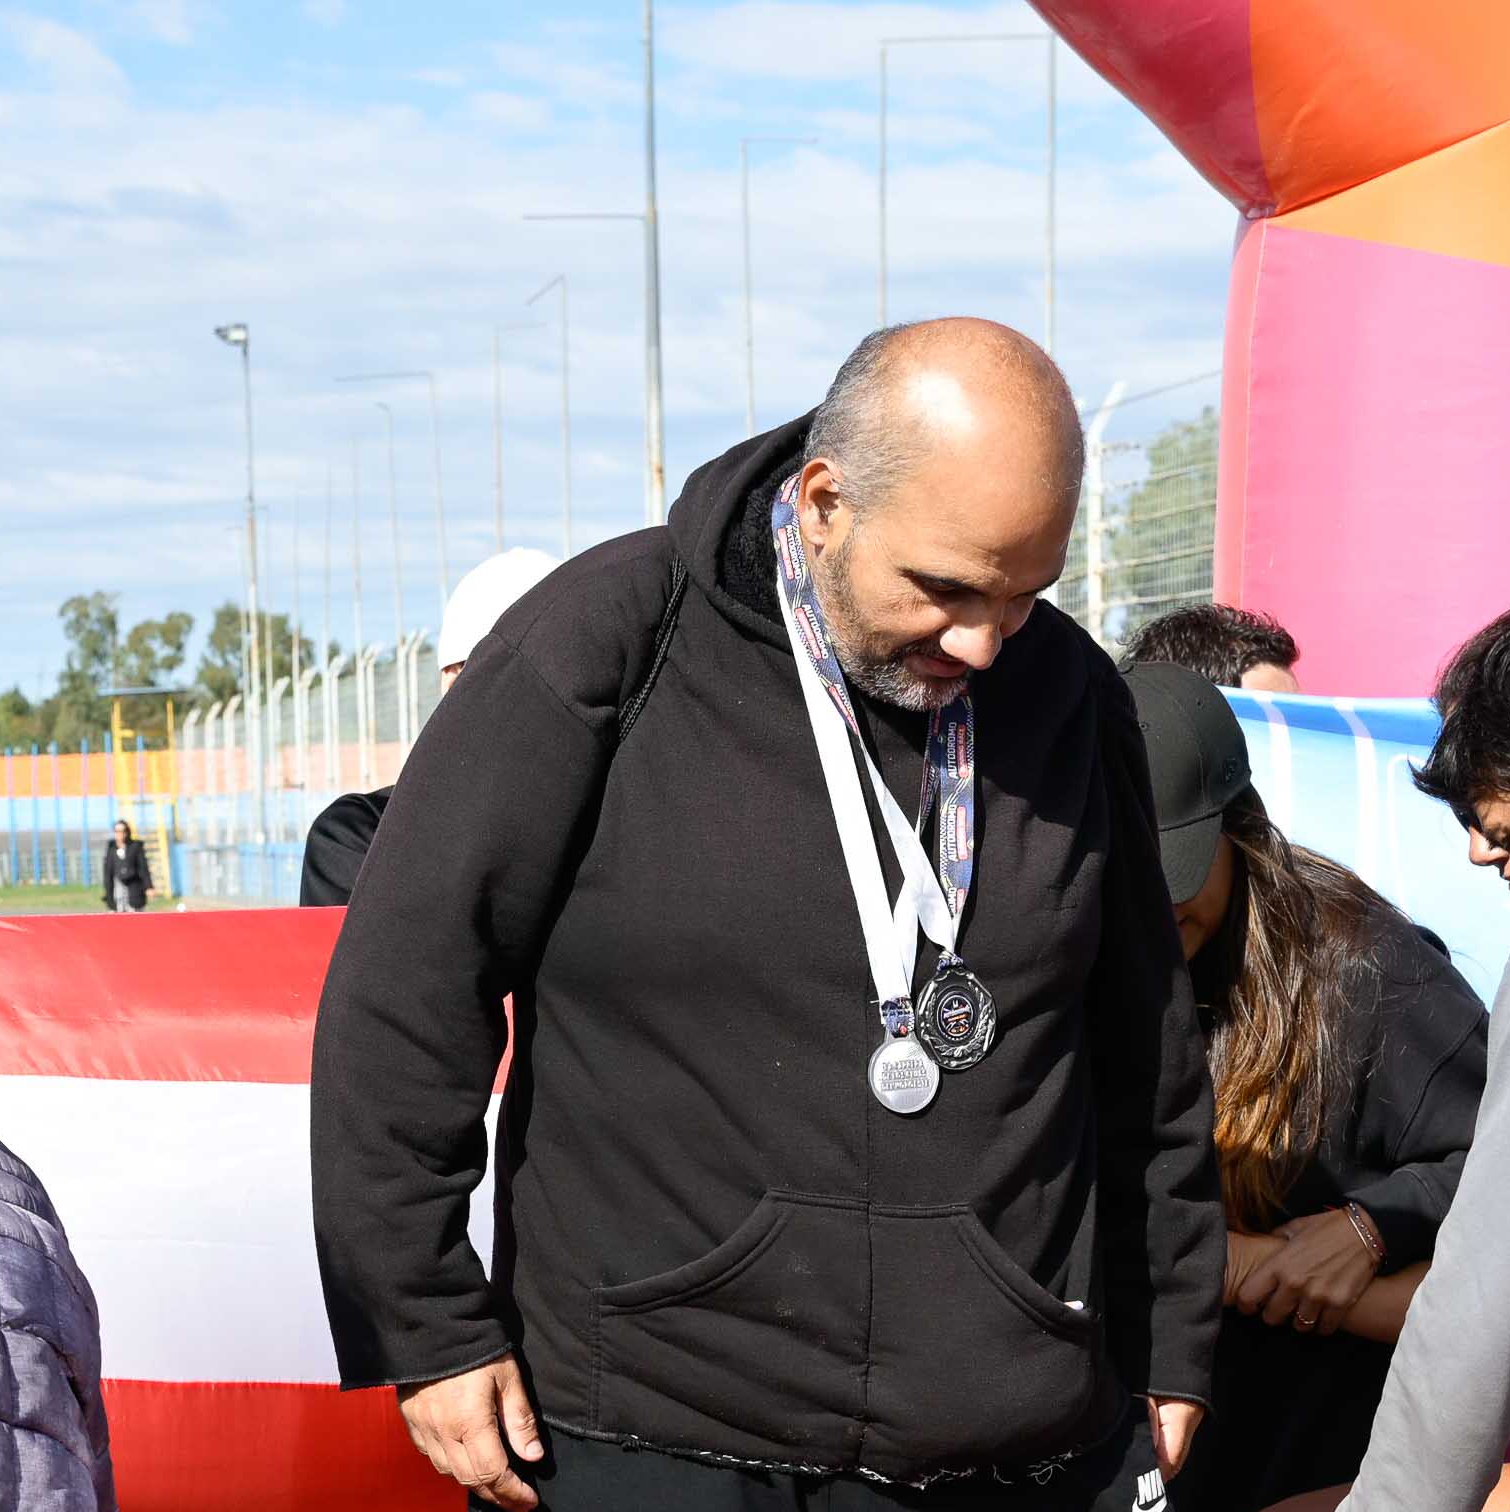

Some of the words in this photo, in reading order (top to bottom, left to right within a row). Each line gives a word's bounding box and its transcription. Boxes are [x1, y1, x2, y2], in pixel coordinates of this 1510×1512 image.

[802, 603, 829, 660] AUTODROMO
[947, 721, 957, 779] AUTODROMO
[947, 803, 957, 862] AUTODROMO
